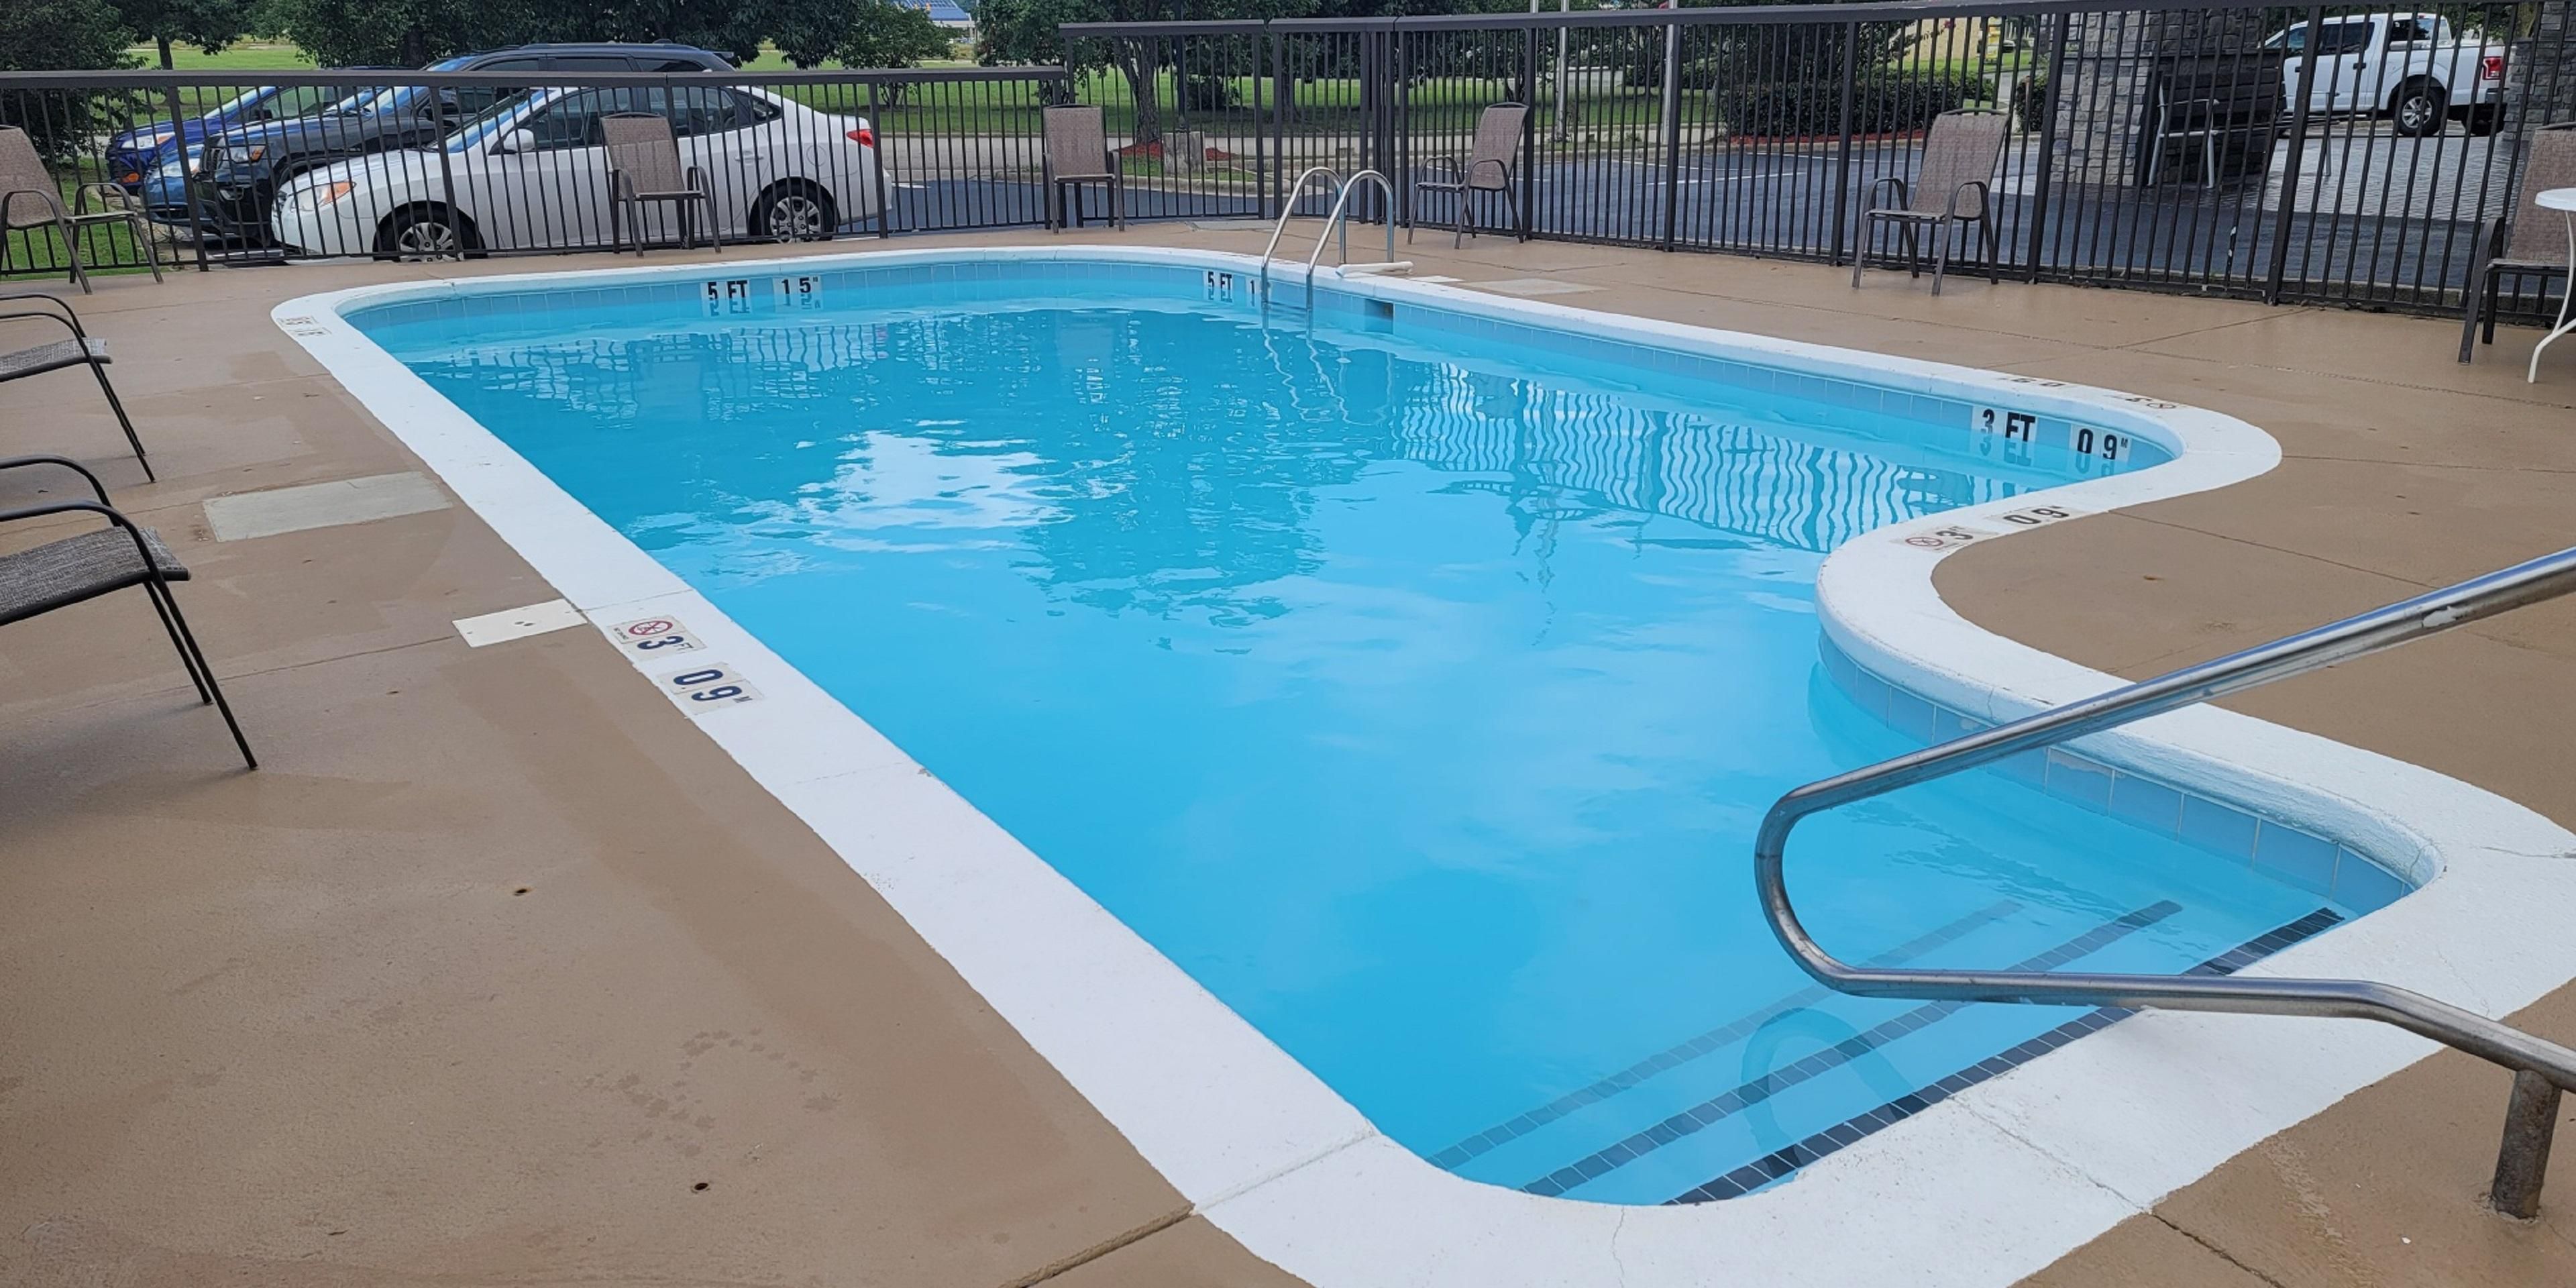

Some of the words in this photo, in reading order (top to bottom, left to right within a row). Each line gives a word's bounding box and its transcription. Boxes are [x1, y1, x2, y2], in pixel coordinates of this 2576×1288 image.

[708, 282, 718, 299] 5
[727, 280, 748, 298] FT
[1208, 271, 1214, 287] 5
[1220, 273, 1232, 290] FT
[1981, 409, 1994, 434] 3
[2005, 411, 2035, 442] FT
